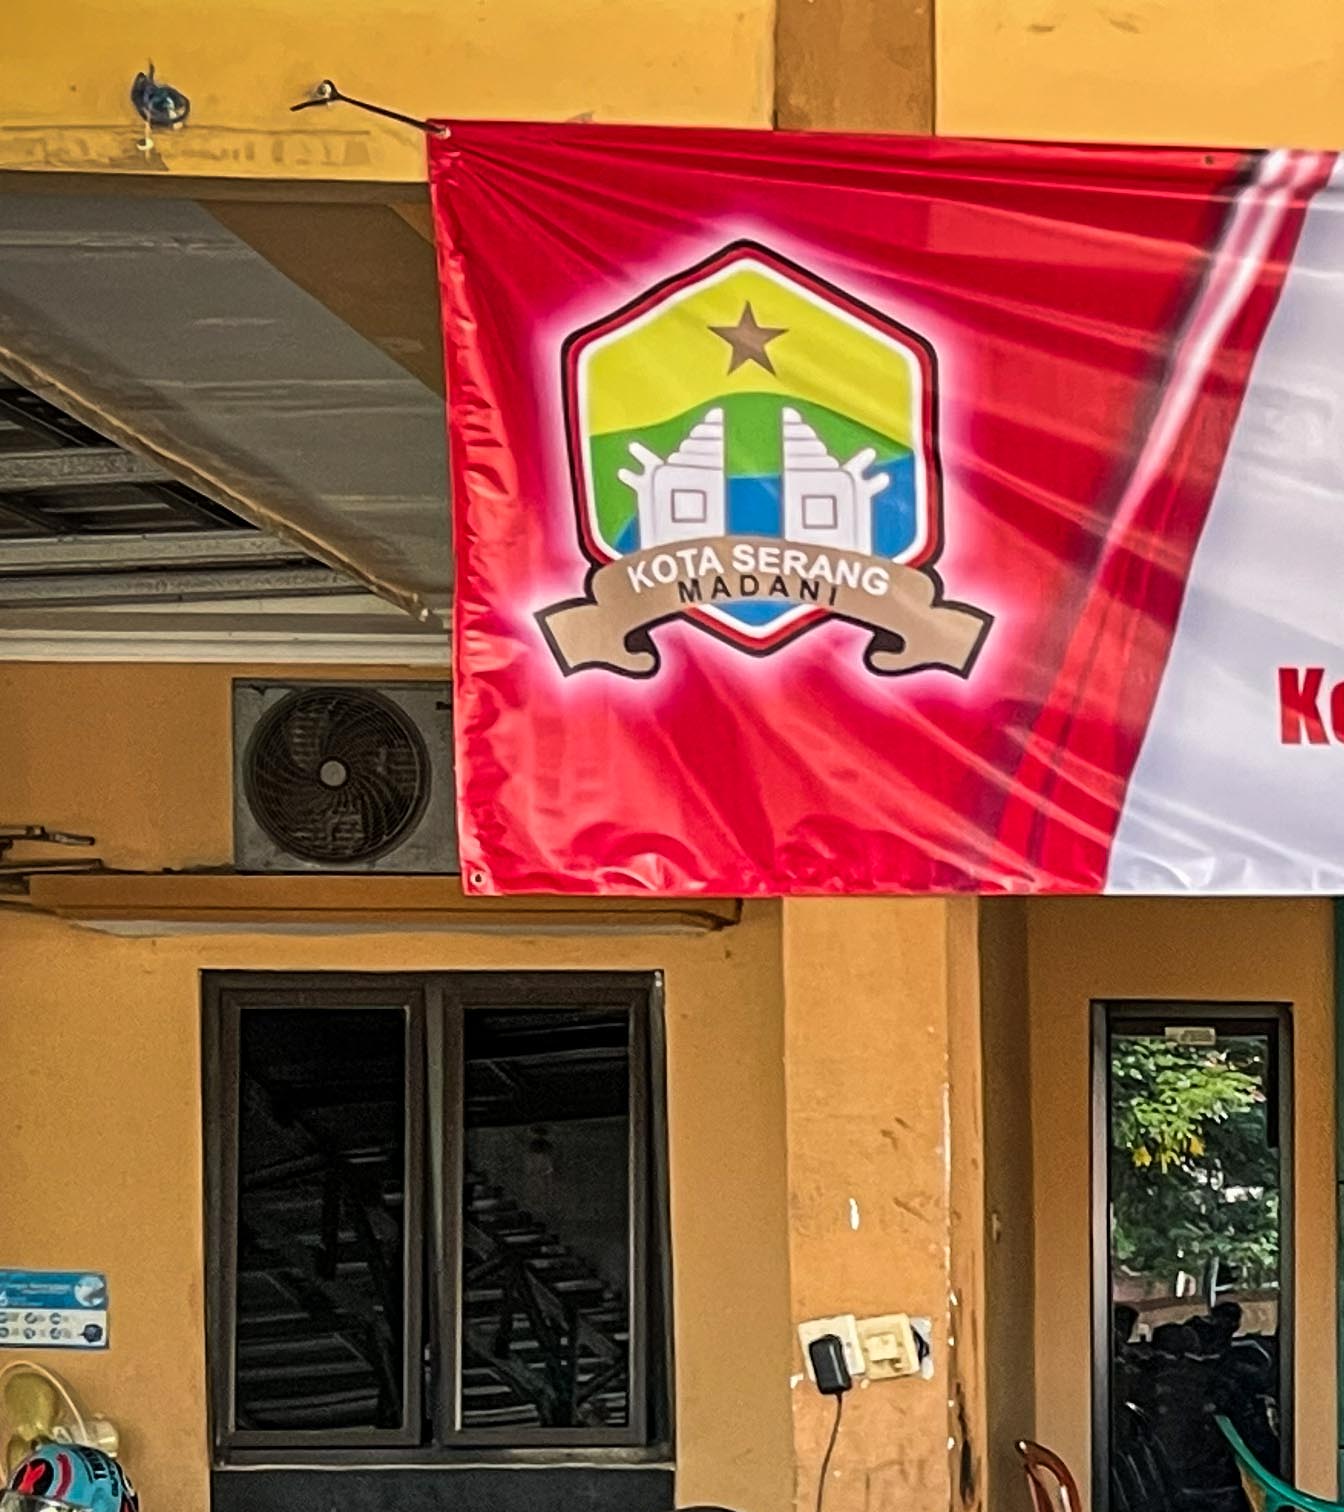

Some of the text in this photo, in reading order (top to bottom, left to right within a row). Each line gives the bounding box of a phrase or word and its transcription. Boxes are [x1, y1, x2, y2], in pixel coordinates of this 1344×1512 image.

[626, 543, 890, 596] KOTA SERANG
[677, 574, 838, 607] MADANI
